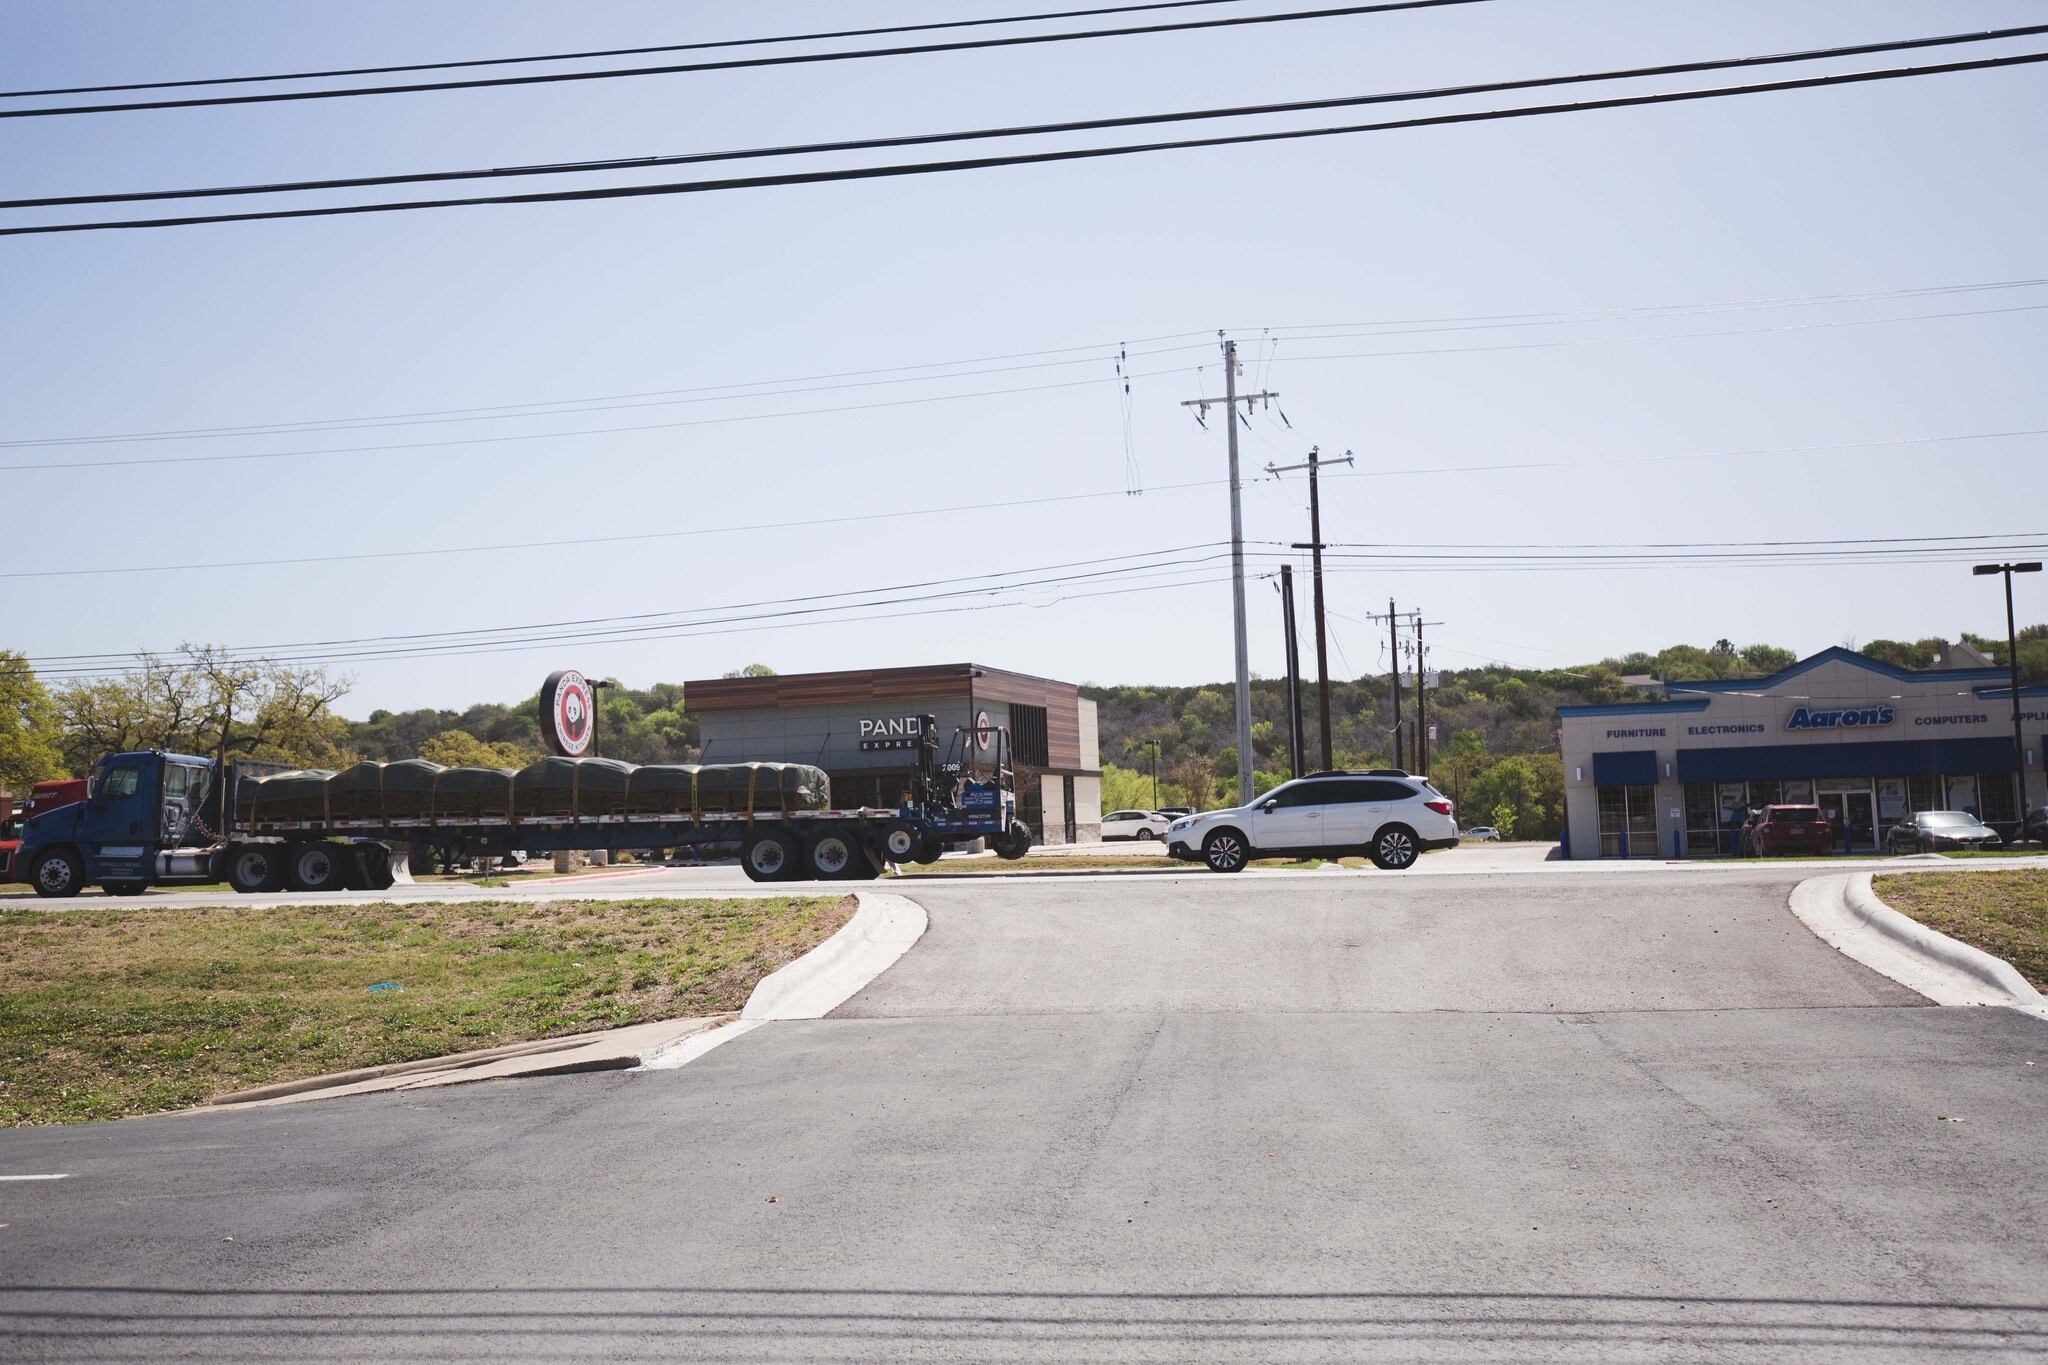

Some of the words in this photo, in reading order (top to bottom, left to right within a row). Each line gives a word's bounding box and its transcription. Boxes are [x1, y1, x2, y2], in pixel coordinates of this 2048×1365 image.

[555, 676, 571, 707] PANDA
[571, 674, 592, 710] EXPRESS
[1786, 706, 1895, 729] Aaron's
[1914, 714, 1988, 726] COMPUTERS
[859, 717, 922, 737] PAND
[1606, 728, 1667, 739] FURNITURE
[1688, 724, 1765, 735] ELECTRONICS
[557, 722, 574, 751] CHINESE
[575, 725, 591, 751] KITCHEN
[863, 741, 912, 749] EXPRE
